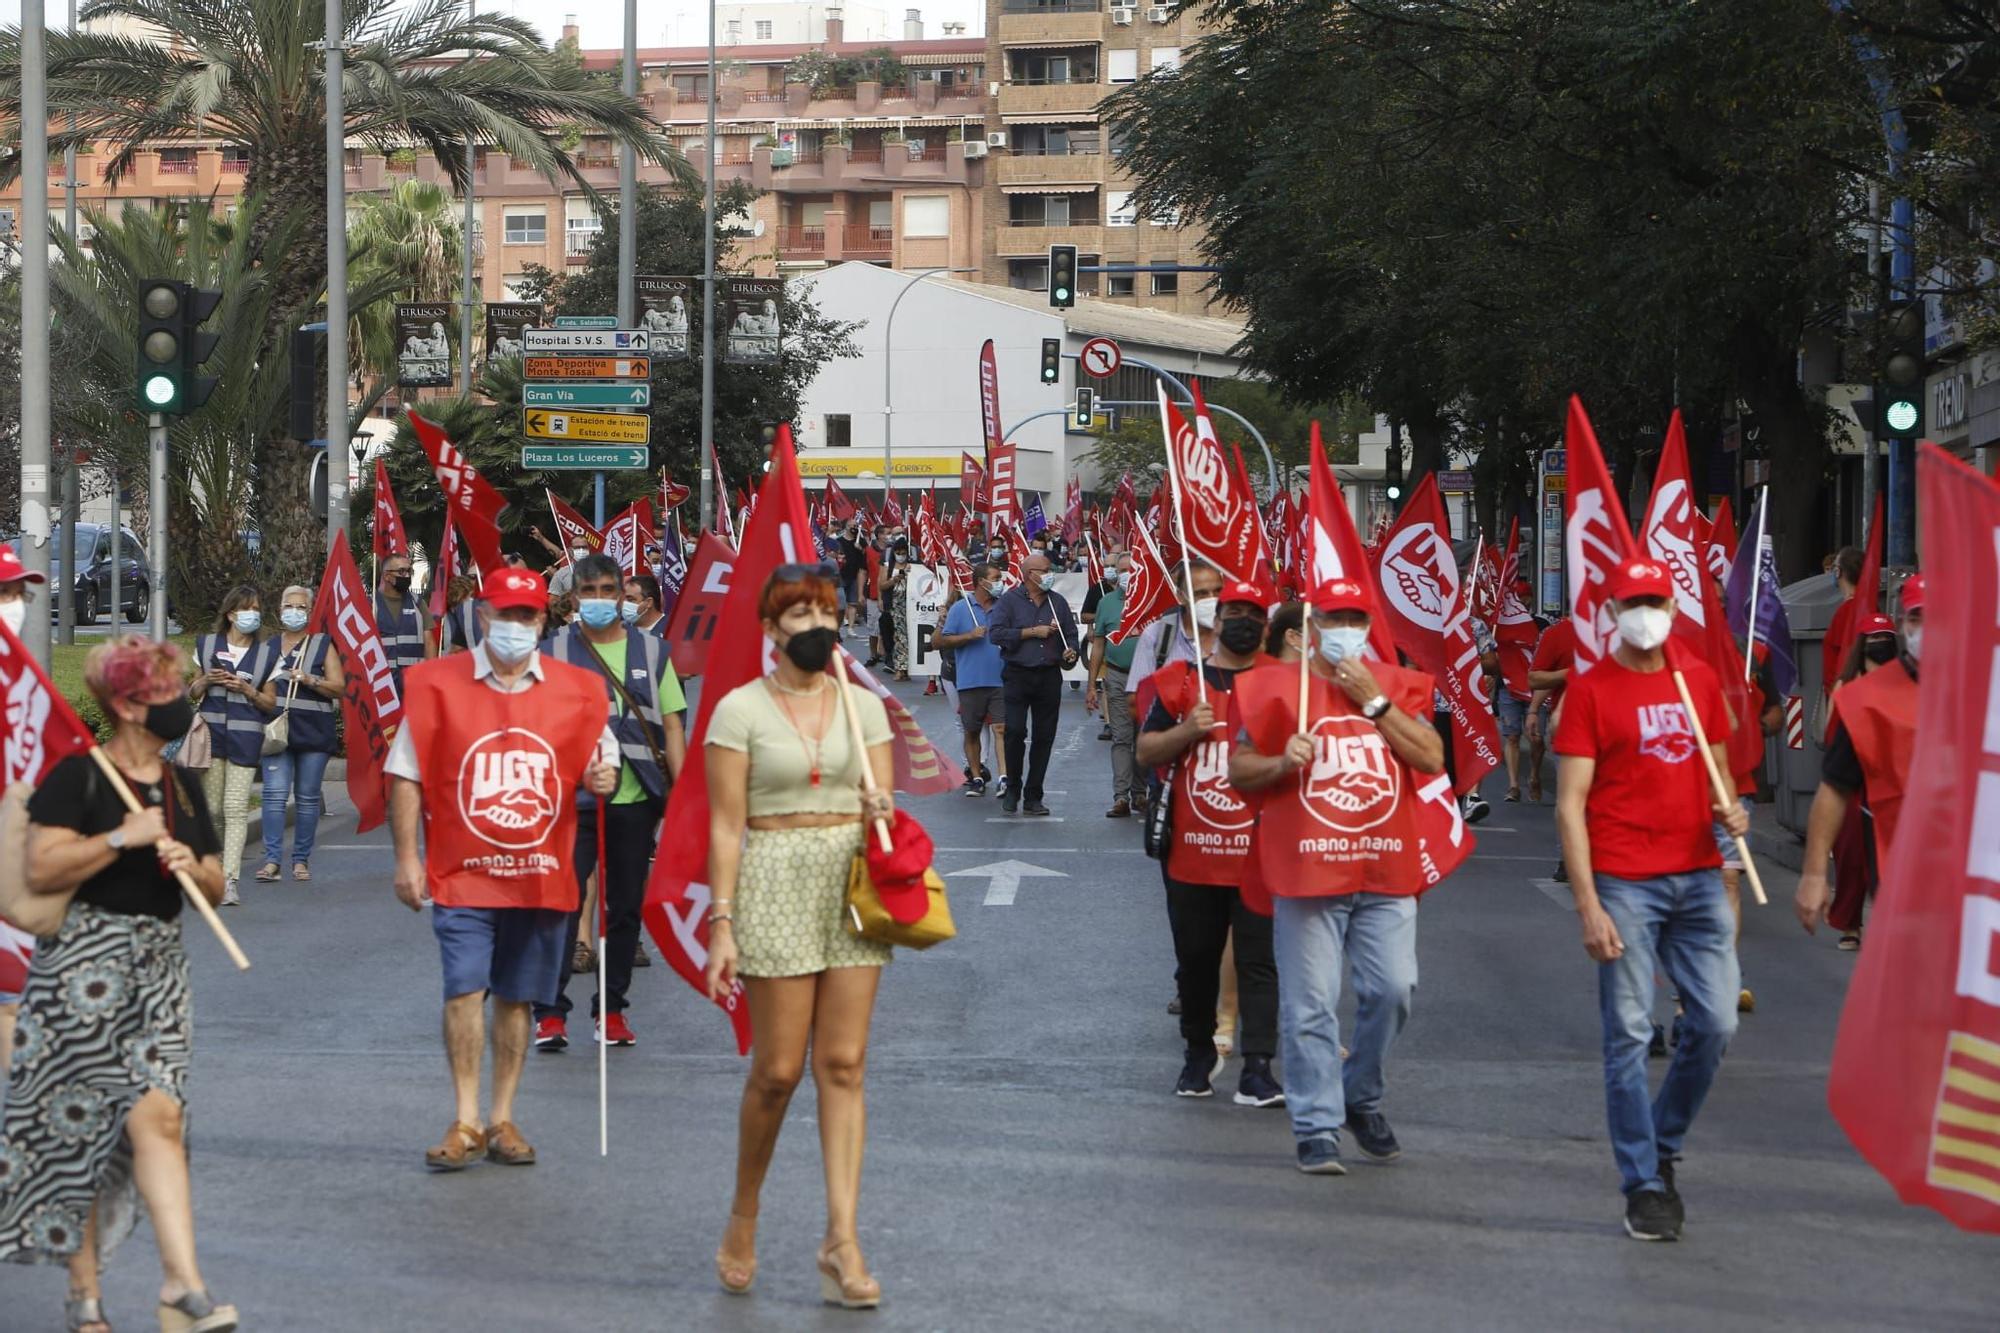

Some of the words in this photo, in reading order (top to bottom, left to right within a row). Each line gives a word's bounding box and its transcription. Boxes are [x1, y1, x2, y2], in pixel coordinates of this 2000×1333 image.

[639, 280, 686, 290] ETRUSCOS
[732, 283, 779, 293] ETRUSCOS
[400, 308, 446, 317] ETRUSCOS
[491, 308, 537, 317] ETRUSCOS
[527, 336, 570, 345] Hospital
[574, 336, 606, 345] S.V.S.
[527, 360, 552, 368] Zona
[557, 360, 607, 369] Deportiva
[527, 368, 560, 376] Monte
[564, 368, 596, 376] Tossal
[527, 391, 553, 400] Gran
[570, 416, 605, 425] Estación
[607, 417, 617, 426] de
[620, 418, 645, 427] trenes
[578, 428, 609, 437] Estació
[610, 429, 620, 438] de
[623, 430, 644, 439] trens
[525, 453, 553, 462] Plaza
[557, 453, 575, 462] Los
[578, 453, 619, 462] Luceros
[811, 464, 848, 472] CORREOS
[895, 464, 933, 472] CORREOS
[1465, 726, 1476, 737] y
[1473, 735, 1498, 766] Agro
[1311, 734, 1389, 781] UGT
[473, 750, 550, 799] UGT
[1185, 832, 1222, 845] mano
[1299, 838, 1349, 853] mano
